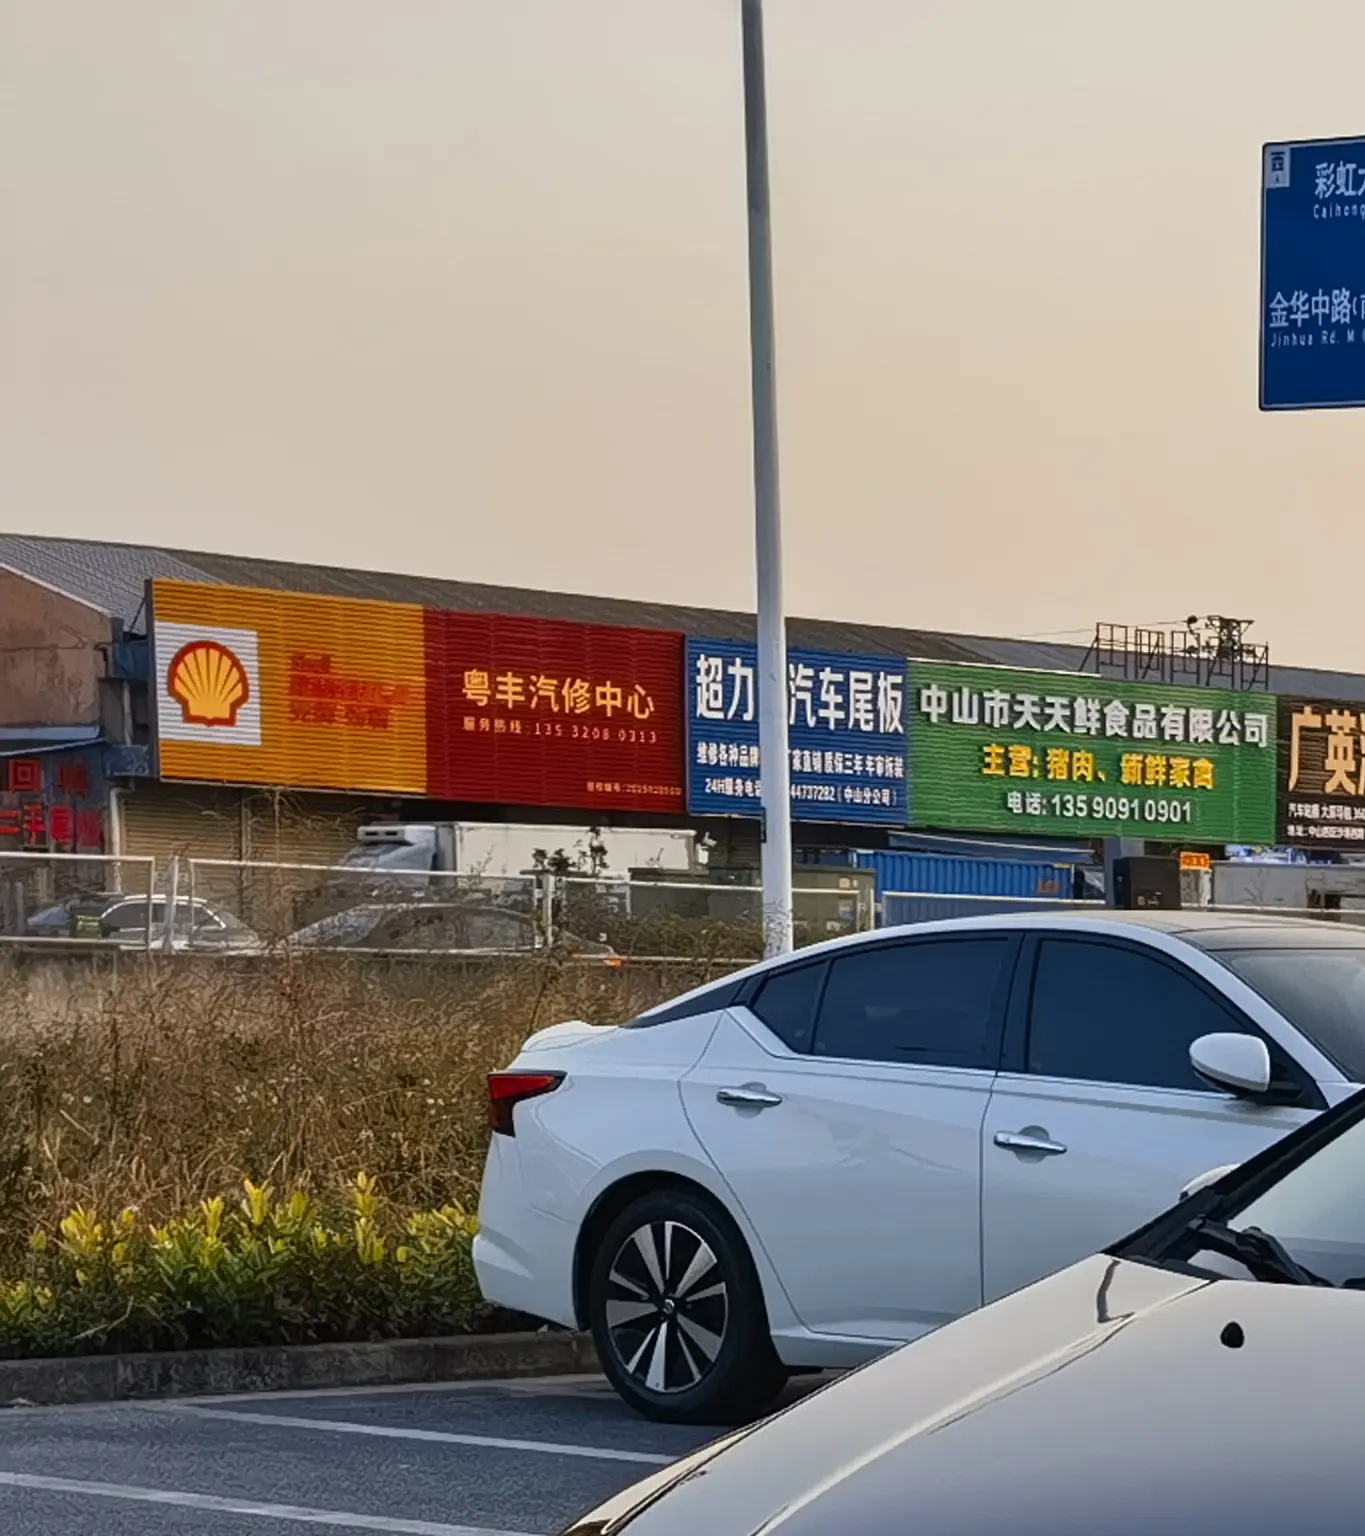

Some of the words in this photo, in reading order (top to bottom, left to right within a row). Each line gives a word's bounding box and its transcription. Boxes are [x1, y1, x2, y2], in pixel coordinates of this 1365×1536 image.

[1313, 203, 1365, 221] Caihong
[1271, 332, 1313, 348] Jinhua
[1321, 329, 1340, 345] Rd.
[462, 669, 655, 720] 粤丰汽修中心
[920, 684, 1269, 748] 中山市天天鲜食品有限公司
